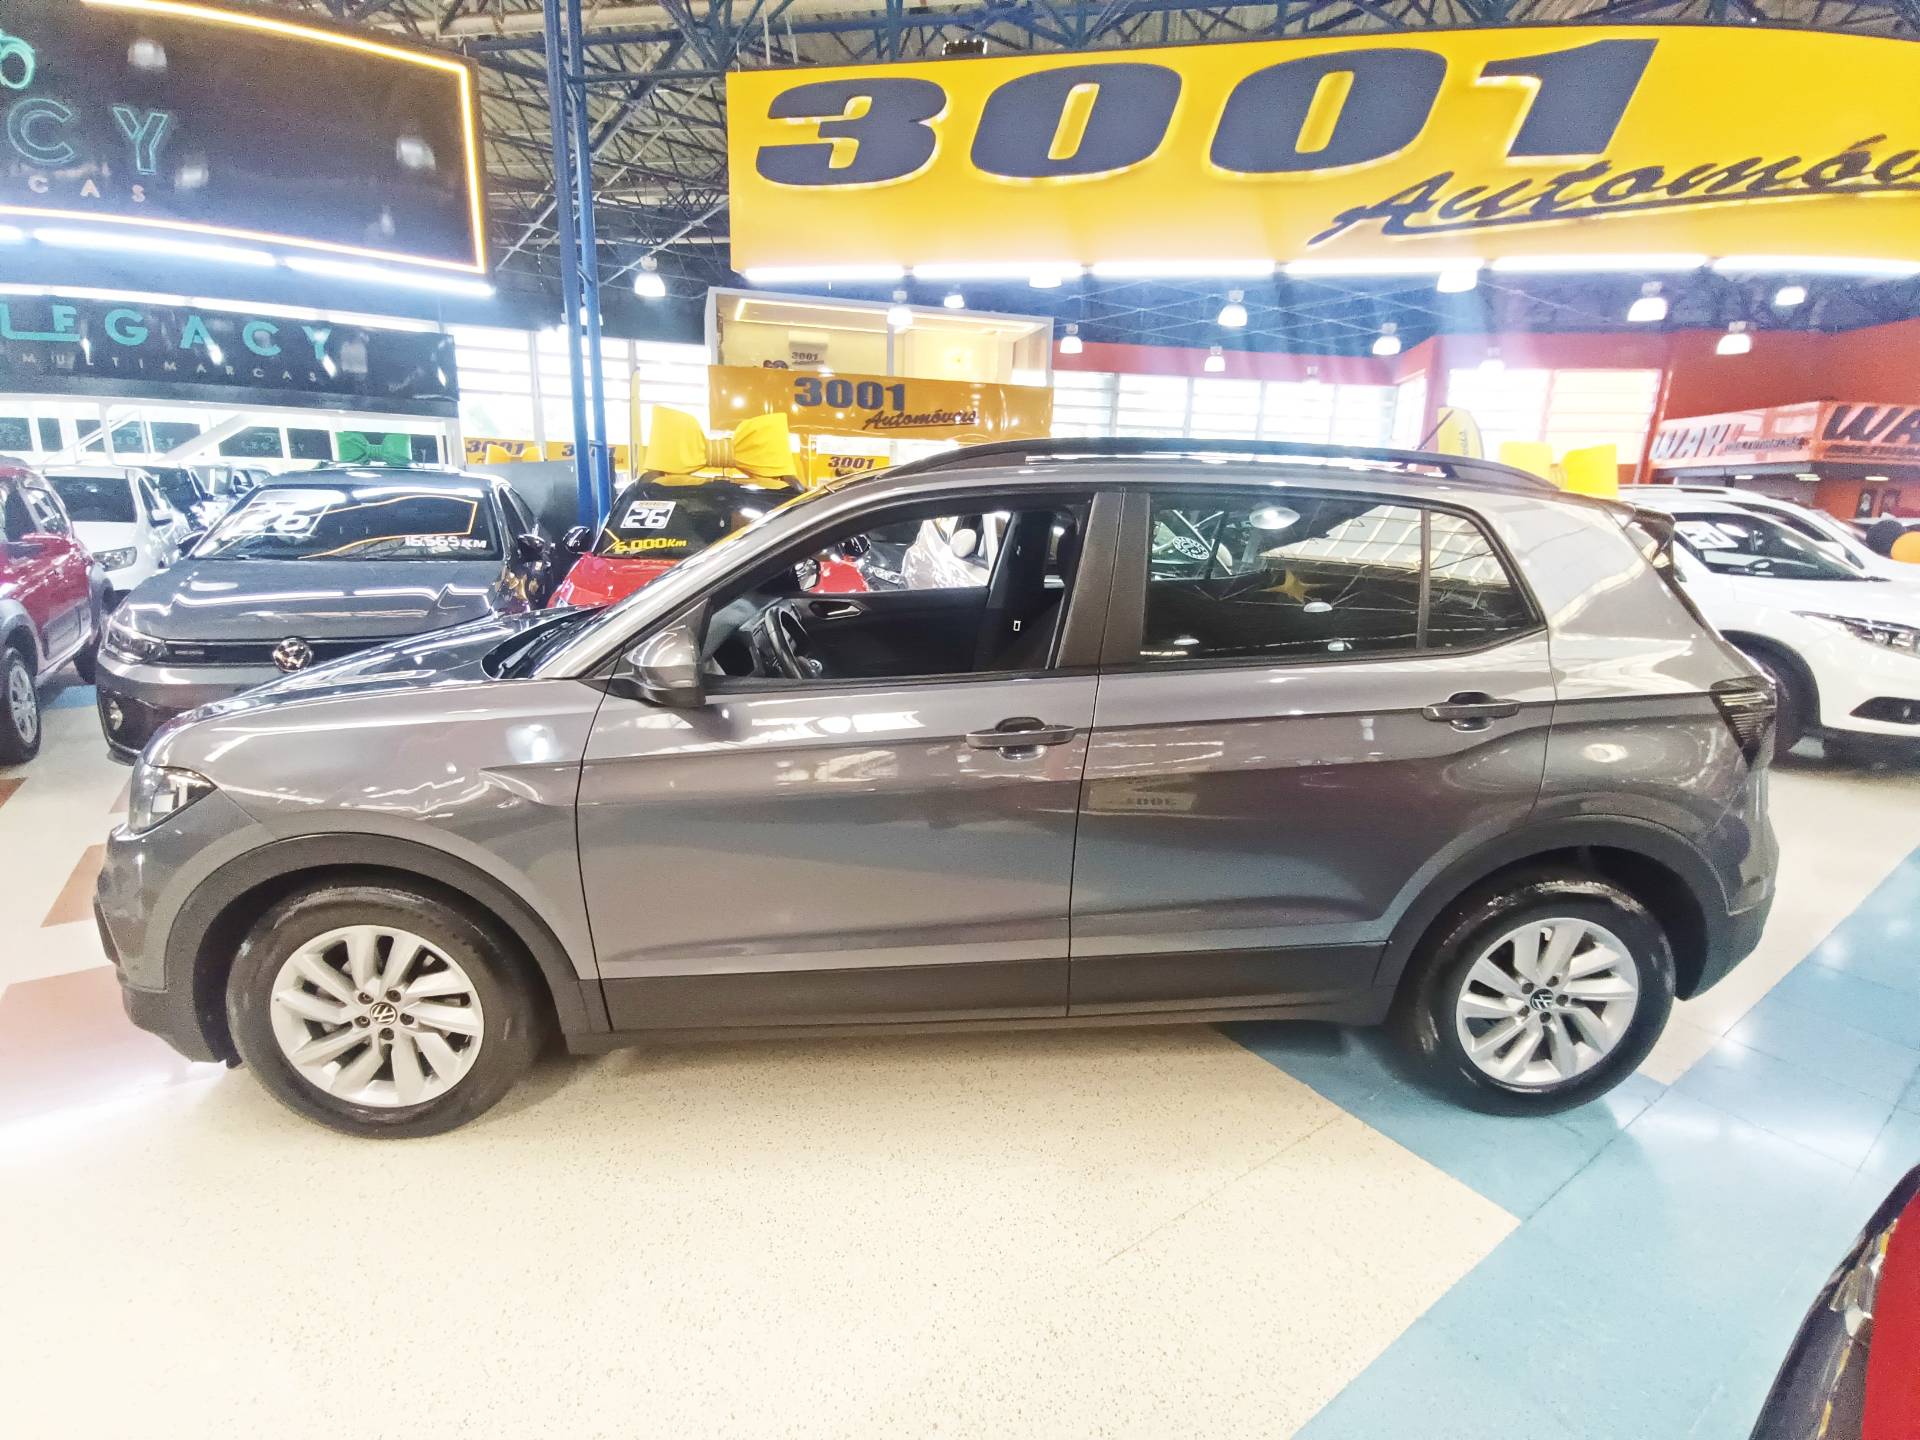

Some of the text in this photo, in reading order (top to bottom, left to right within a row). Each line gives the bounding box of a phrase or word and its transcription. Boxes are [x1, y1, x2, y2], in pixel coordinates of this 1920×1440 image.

[755, 38, 1660, 187] 3001
[0, 302, 332, 361] LEGACY
[22, 351, 317, 383] MULTIMARCAS
[794, 377, 905, 411] 3001
[828, 456, 875, 470] 3001
[627, 507, 669, 528] 26
